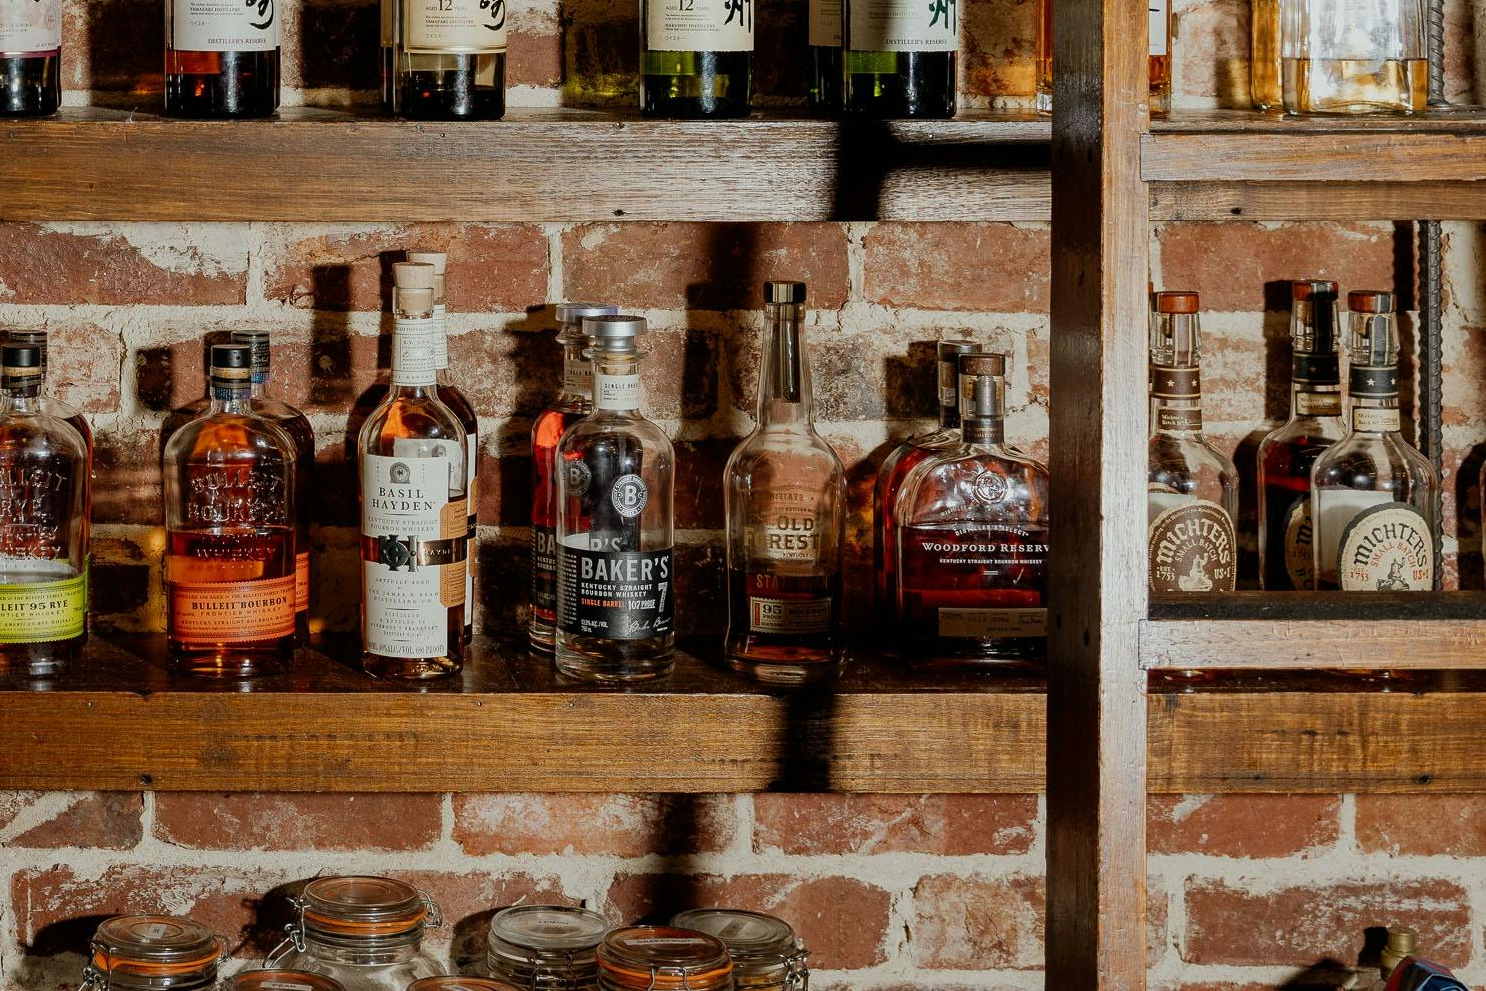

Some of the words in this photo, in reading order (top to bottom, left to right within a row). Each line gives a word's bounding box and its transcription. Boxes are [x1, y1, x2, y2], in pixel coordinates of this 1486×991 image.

[379, 487, 424, 498] BASIL
[624, 485, 637, 506] B
[372, 498, 433, 511] HAYDEN
[777, 515, 814, 531] OLD
[922, 542, 995, 553] WOODFORD
[1156, 518, 1231, 564] MICHTER'S
[1354, 523, 1427, 567] MICHTER'S
[1175, 539, 1197, 562] SMALL
[1200, 539, 1218, 561] BATCH
[1371, 542, 1394, 567] SMALL
[1397, 542, 1416, 568] BATCH
[581, 556, 669, 582] BAKER'S
[1156, 571, 1175, 581] 1753
[1350, 572, 1369, 582] 1753
[581, 583, 617, 591] KENTUCKY
[581, 589, 613, 598] BOURBON
[192, 601, 240, 610] BULLEIT
[241, 596, 288, 609] BOURBON
[581, 598, 601, 607] SINGLE
[658, 581, 668, 613] 7
[49, 600, 68, 609] RYE
[763, 604, 782, 614] 95
